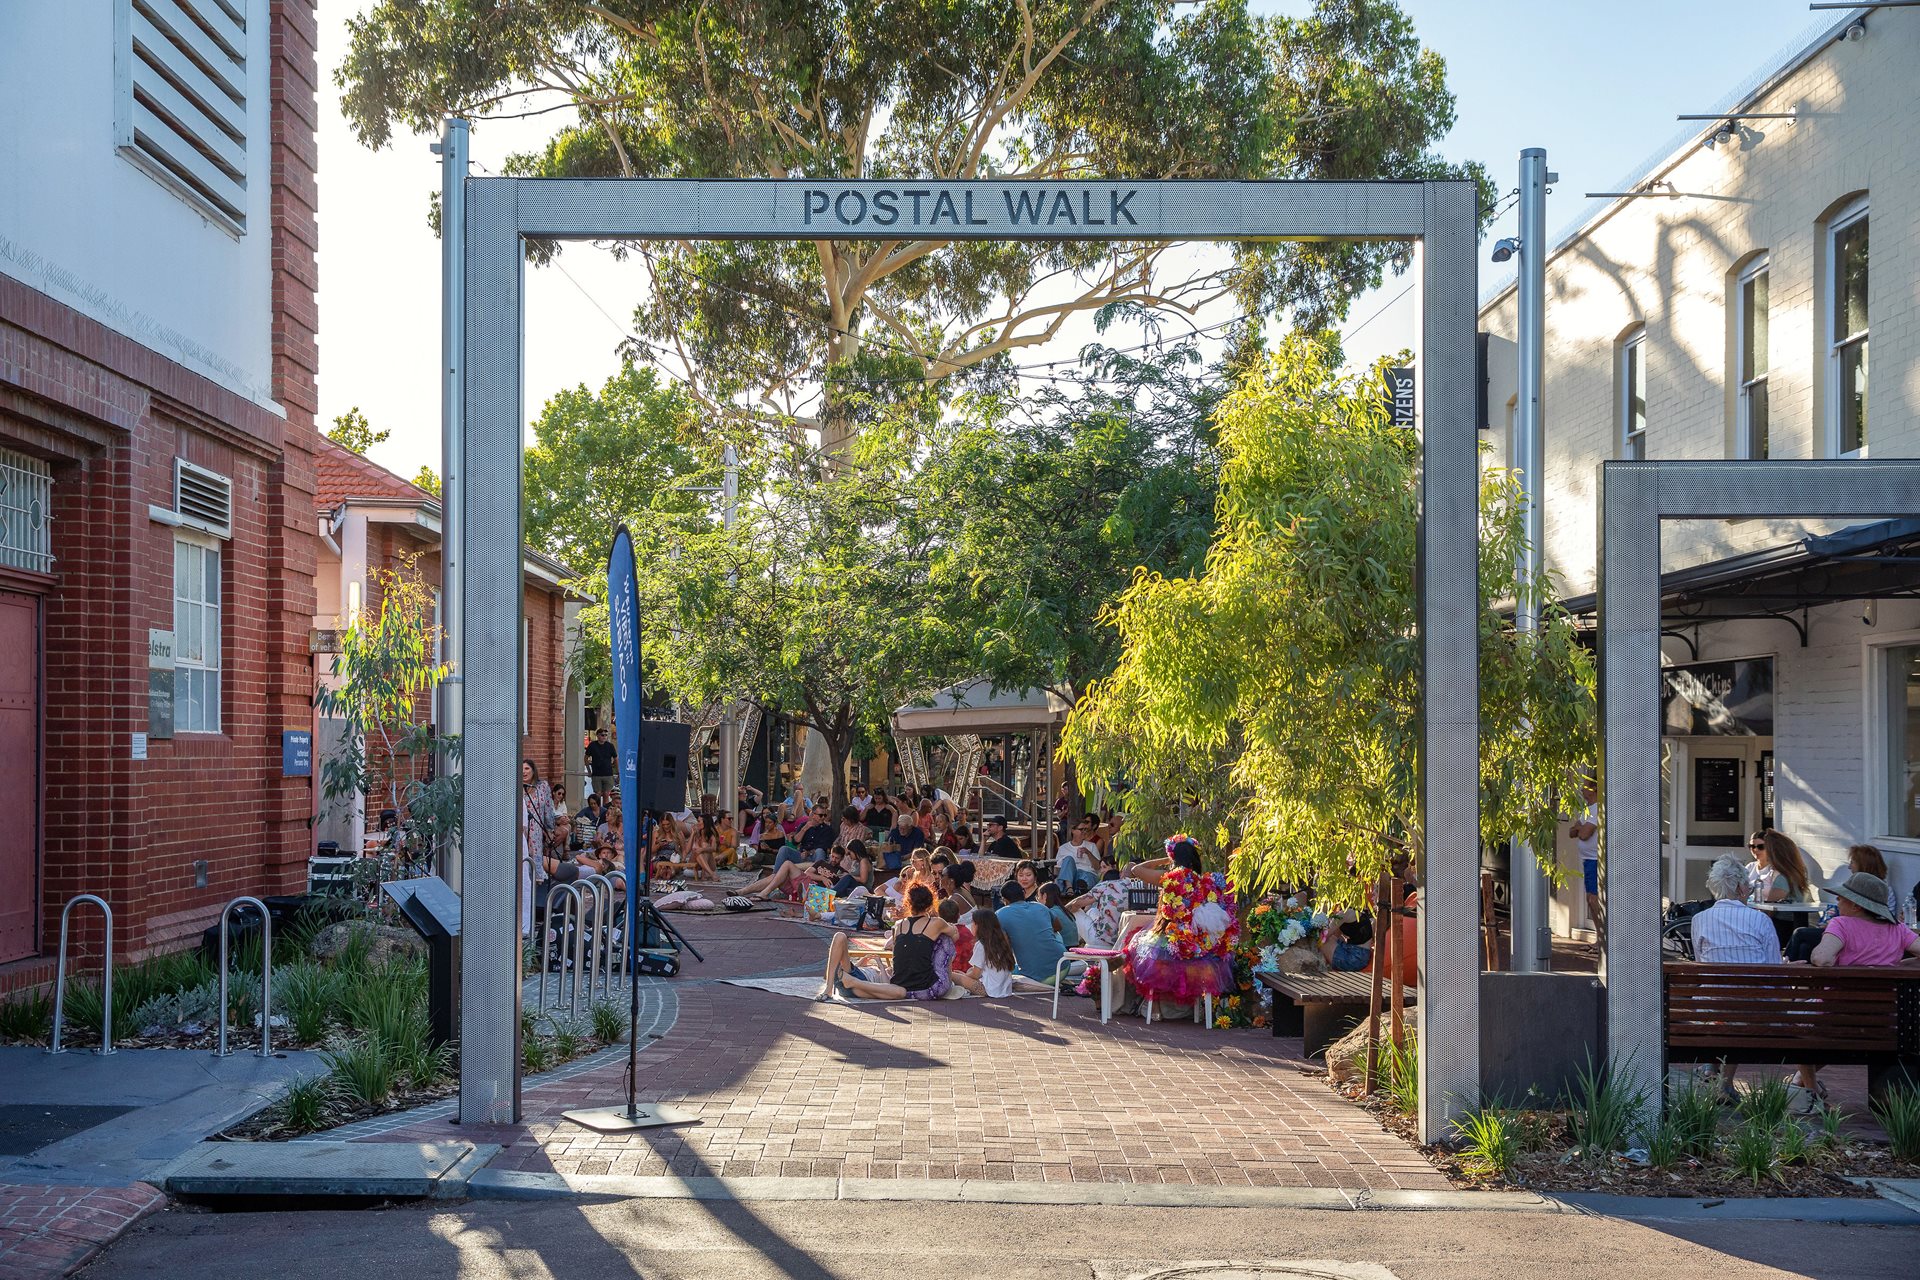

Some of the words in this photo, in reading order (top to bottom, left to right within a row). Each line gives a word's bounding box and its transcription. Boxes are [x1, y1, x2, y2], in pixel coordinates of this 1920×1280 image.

[804, 190, 988, 225] POSTAL
[1003, 190, 1138, 225] WALK
[615, 593, 627, 702] SUBIACO
